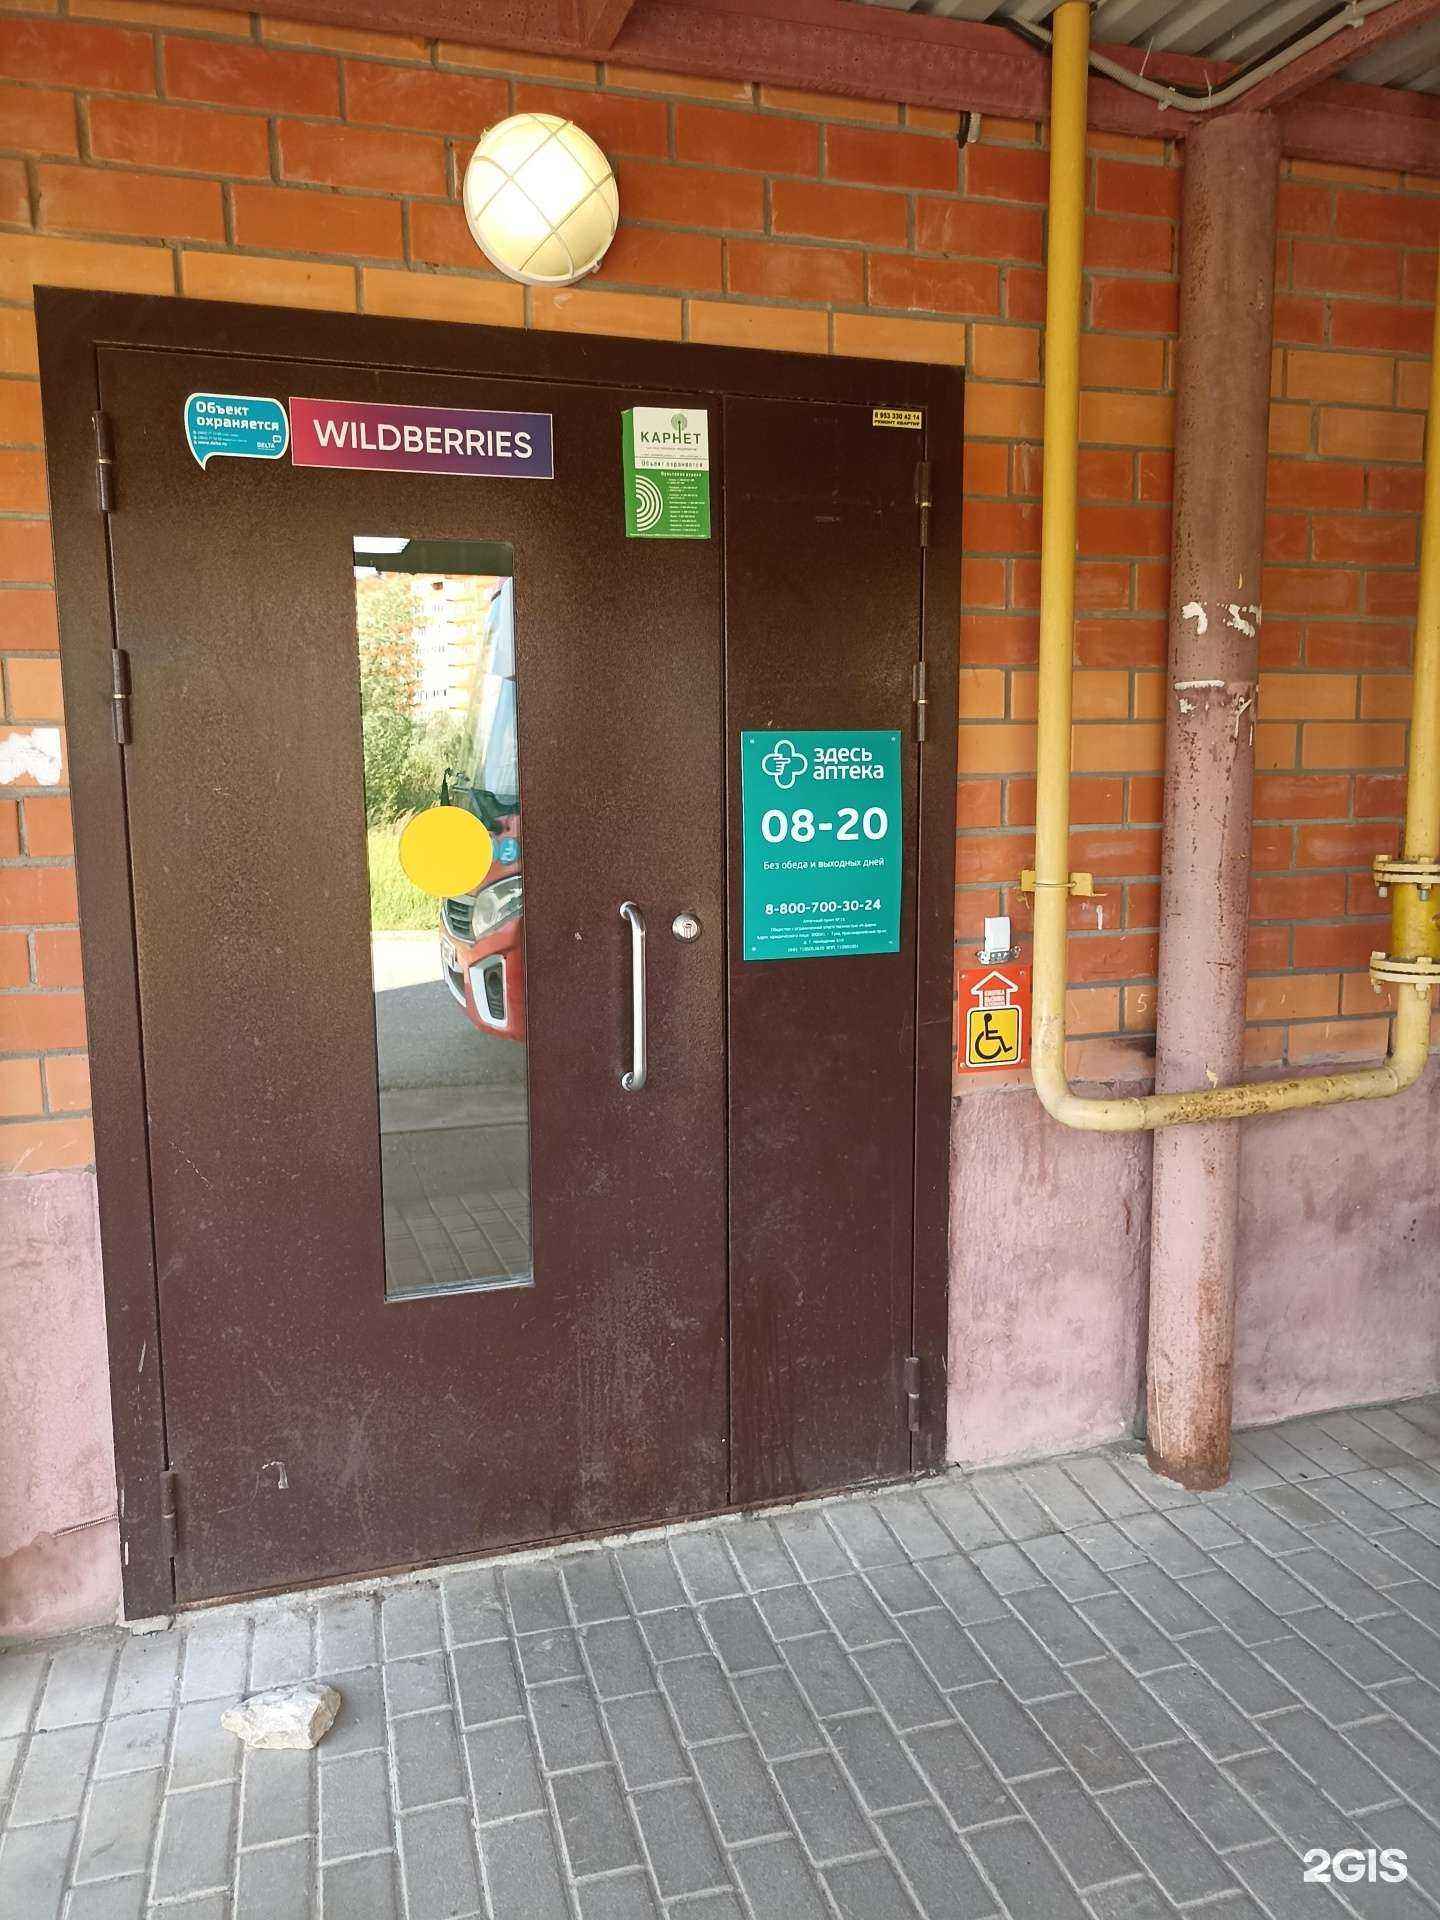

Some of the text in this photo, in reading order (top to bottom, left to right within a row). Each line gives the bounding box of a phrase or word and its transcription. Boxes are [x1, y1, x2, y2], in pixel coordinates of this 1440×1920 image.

[195, 401, 249, 416] Объект
[196, 416, 279, 431] охраняется
[313, 419, 533, 459] WILDBERRIES
[640, 431, 701, 445] КАРНЕТ
[813, 747, 873, 764] здесь
[813, 763, 885, 780] аптека
[761, 806, 888, 843] 08-20
[763, 861, 779, 870] Без
[781, 860, 808, 870] обеда
[818, 859, 861, 869] выходных
[863, 857, 885, 868] дней
[764, 898, 881, 915] 8-800-700-30-24
[1136, 993, 1150, 1013] 5
